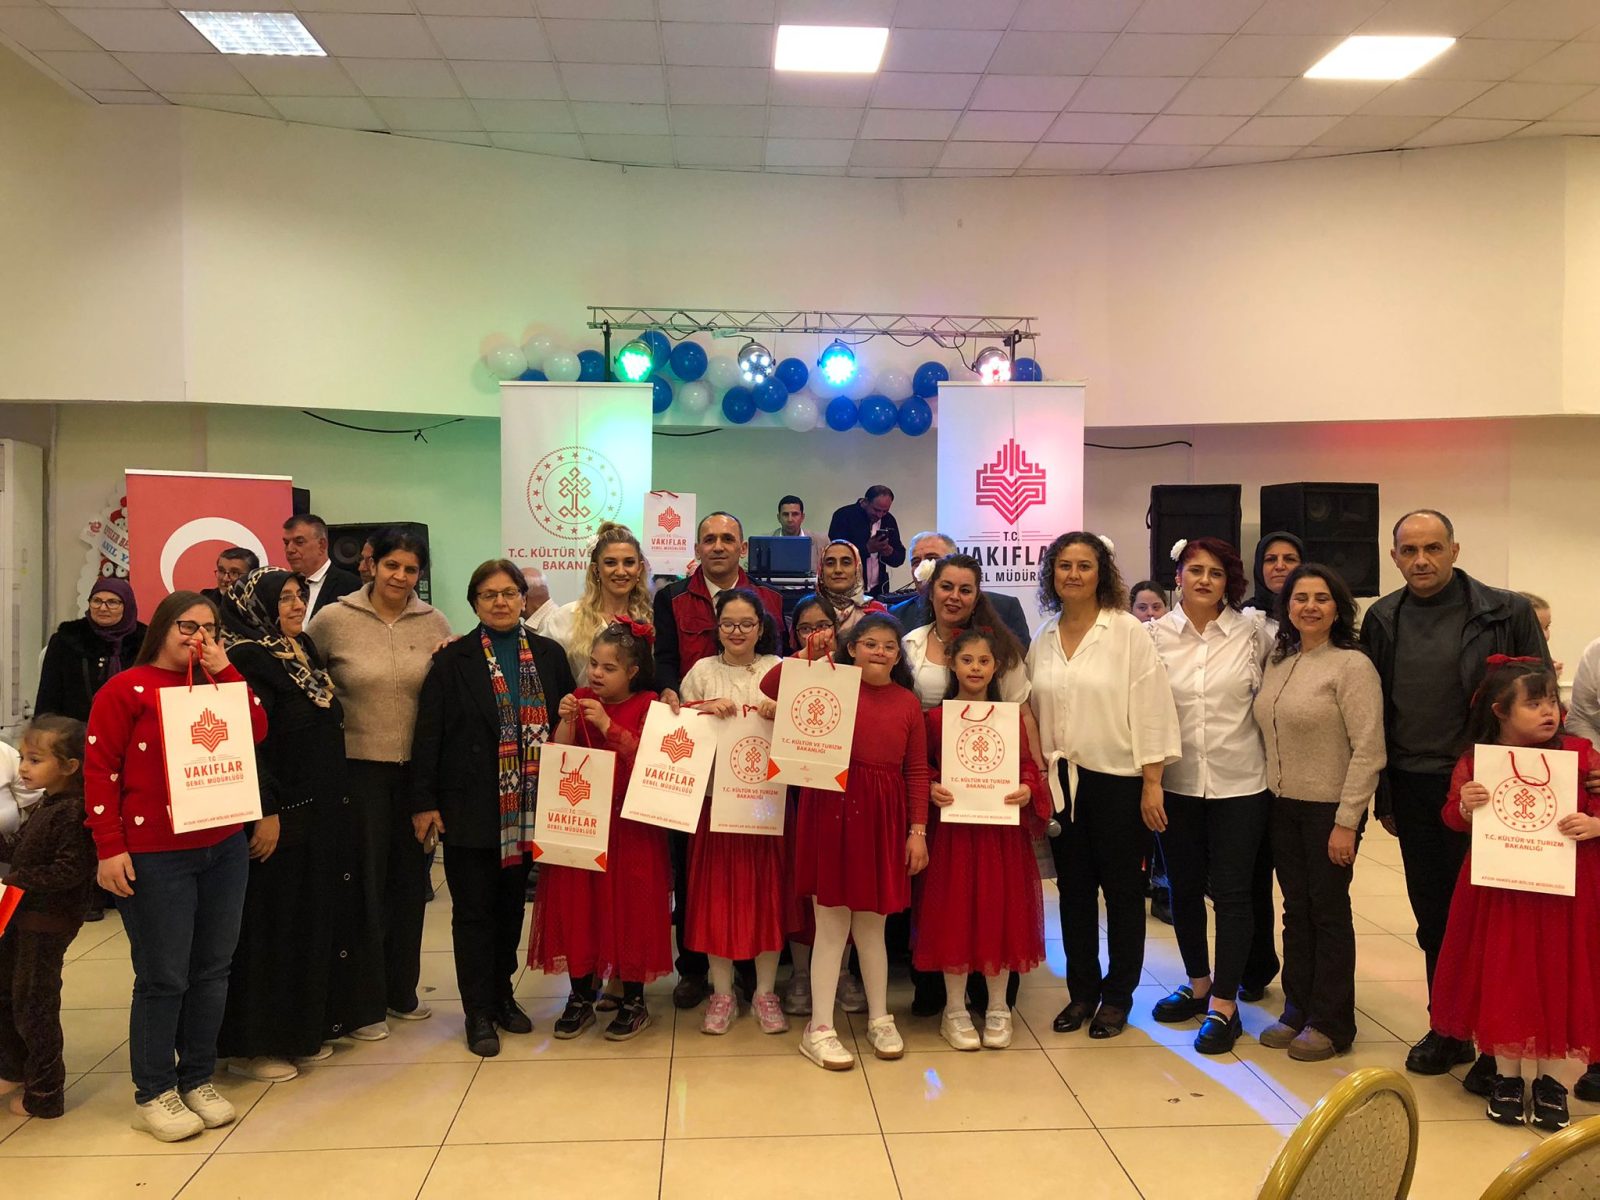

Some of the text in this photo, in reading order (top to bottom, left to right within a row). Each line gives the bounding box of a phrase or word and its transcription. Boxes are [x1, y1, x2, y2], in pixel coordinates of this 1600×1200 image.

[1003, 532, 1020, 541] T.C.
[508, 548, 528, 558] T.C.
[530, 546, 576, 558] KÜLTÜR
[796, 746, 826, 754] BAKANLIĞI
[184, 760, 242, 778] VAKIFLAR
[645, 768, 696, 787] VAKIFLAR
[548, 812, 597, 828] VAKIFLAR
[1498, 834, 1524, 843] KÜLTÜR
[1504, 842, 1543, 852] BAKANLIĞI
